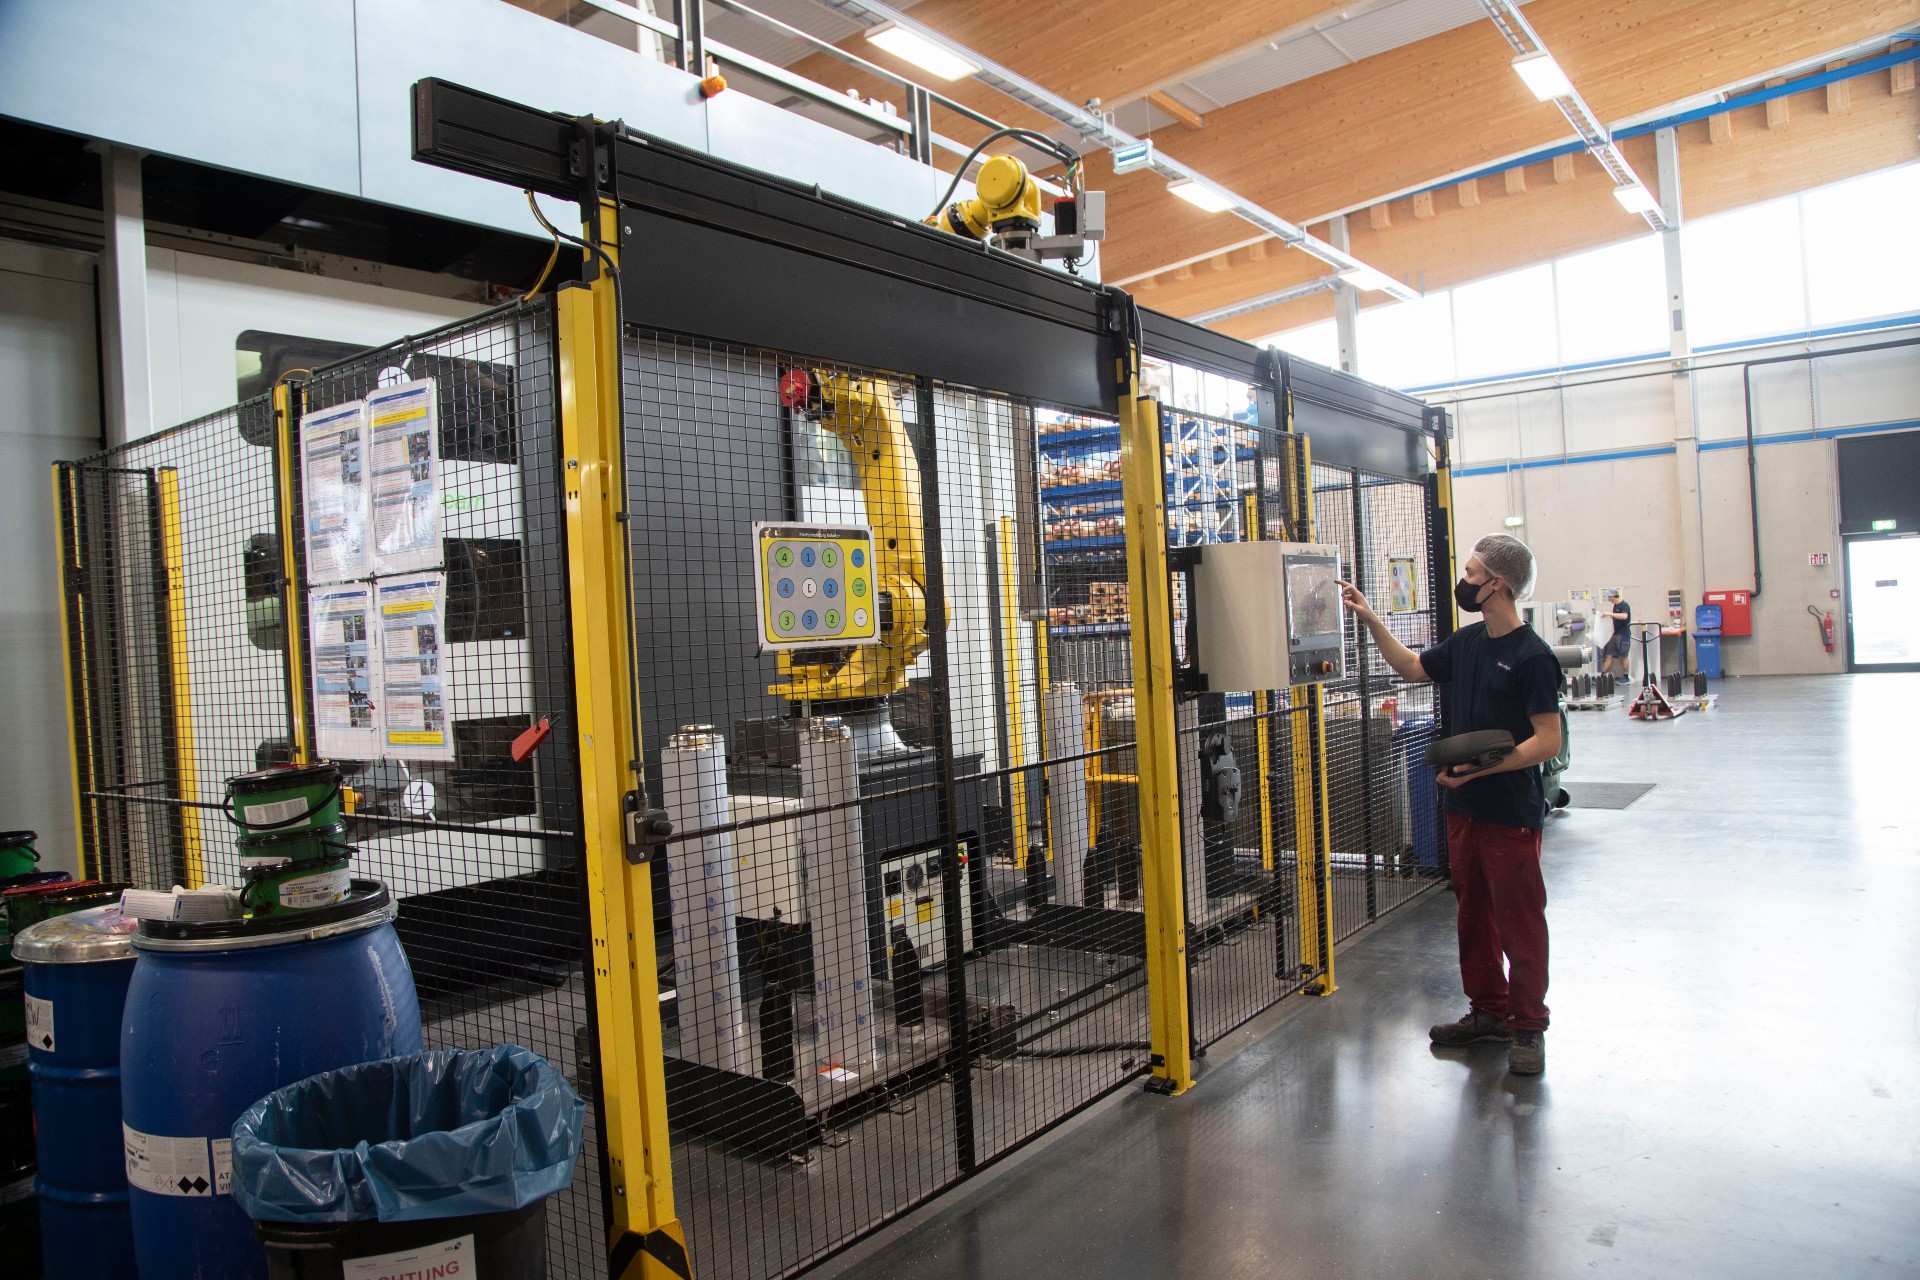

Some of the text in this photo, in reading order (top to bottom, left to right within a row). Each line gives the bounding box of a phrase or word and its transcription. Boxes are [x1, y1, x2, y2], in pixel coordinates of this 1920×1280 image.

[782, 553, 831, 563] 4 1 1
[782, 584, 789, 593] 4
[828, 584, 833, 592] 2
[785, 614, 835, 625] 3 3 2
[413, 783, 427, 806] 4
[365, 1260, 459, 1280] HTUNG
